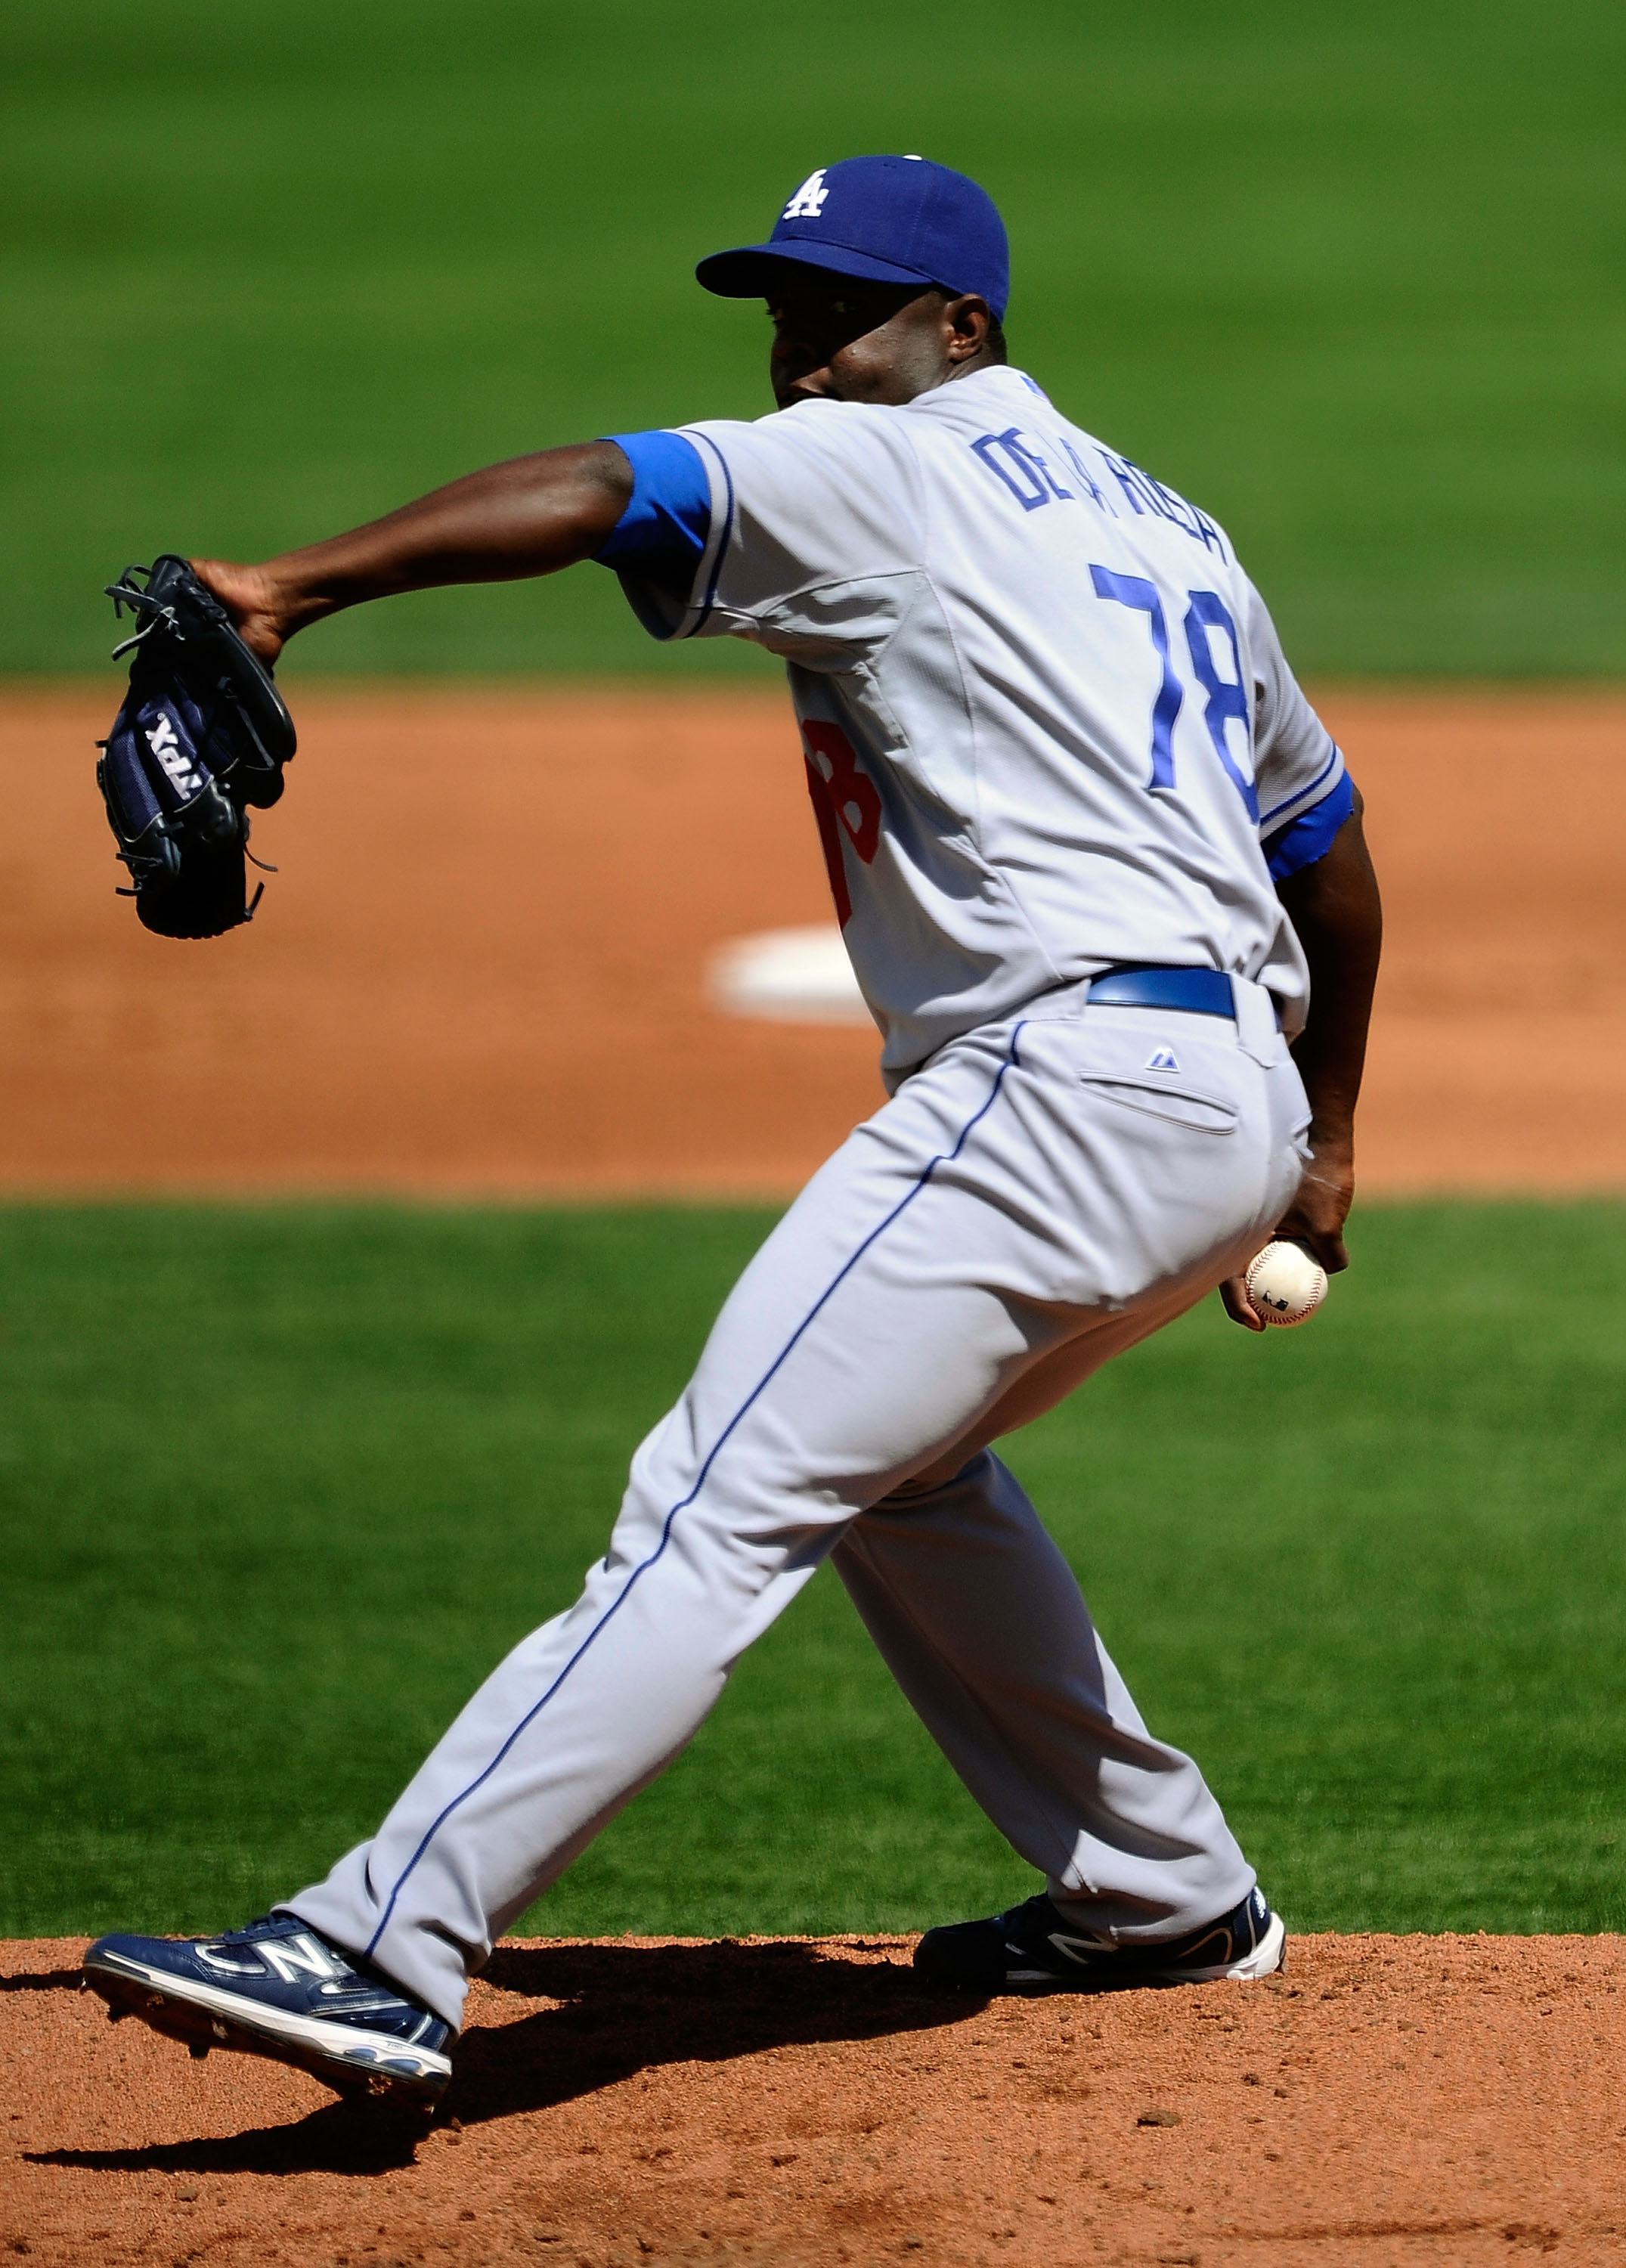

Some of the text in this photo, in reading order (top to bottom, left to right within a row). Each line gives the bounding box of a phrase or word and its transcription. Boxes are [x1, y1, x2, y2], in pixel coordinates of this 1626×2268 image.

[782, 169, 829, 220] LA
[968, 427, 1076, 512] DE
[1088, 562, 1260, 826] 78
